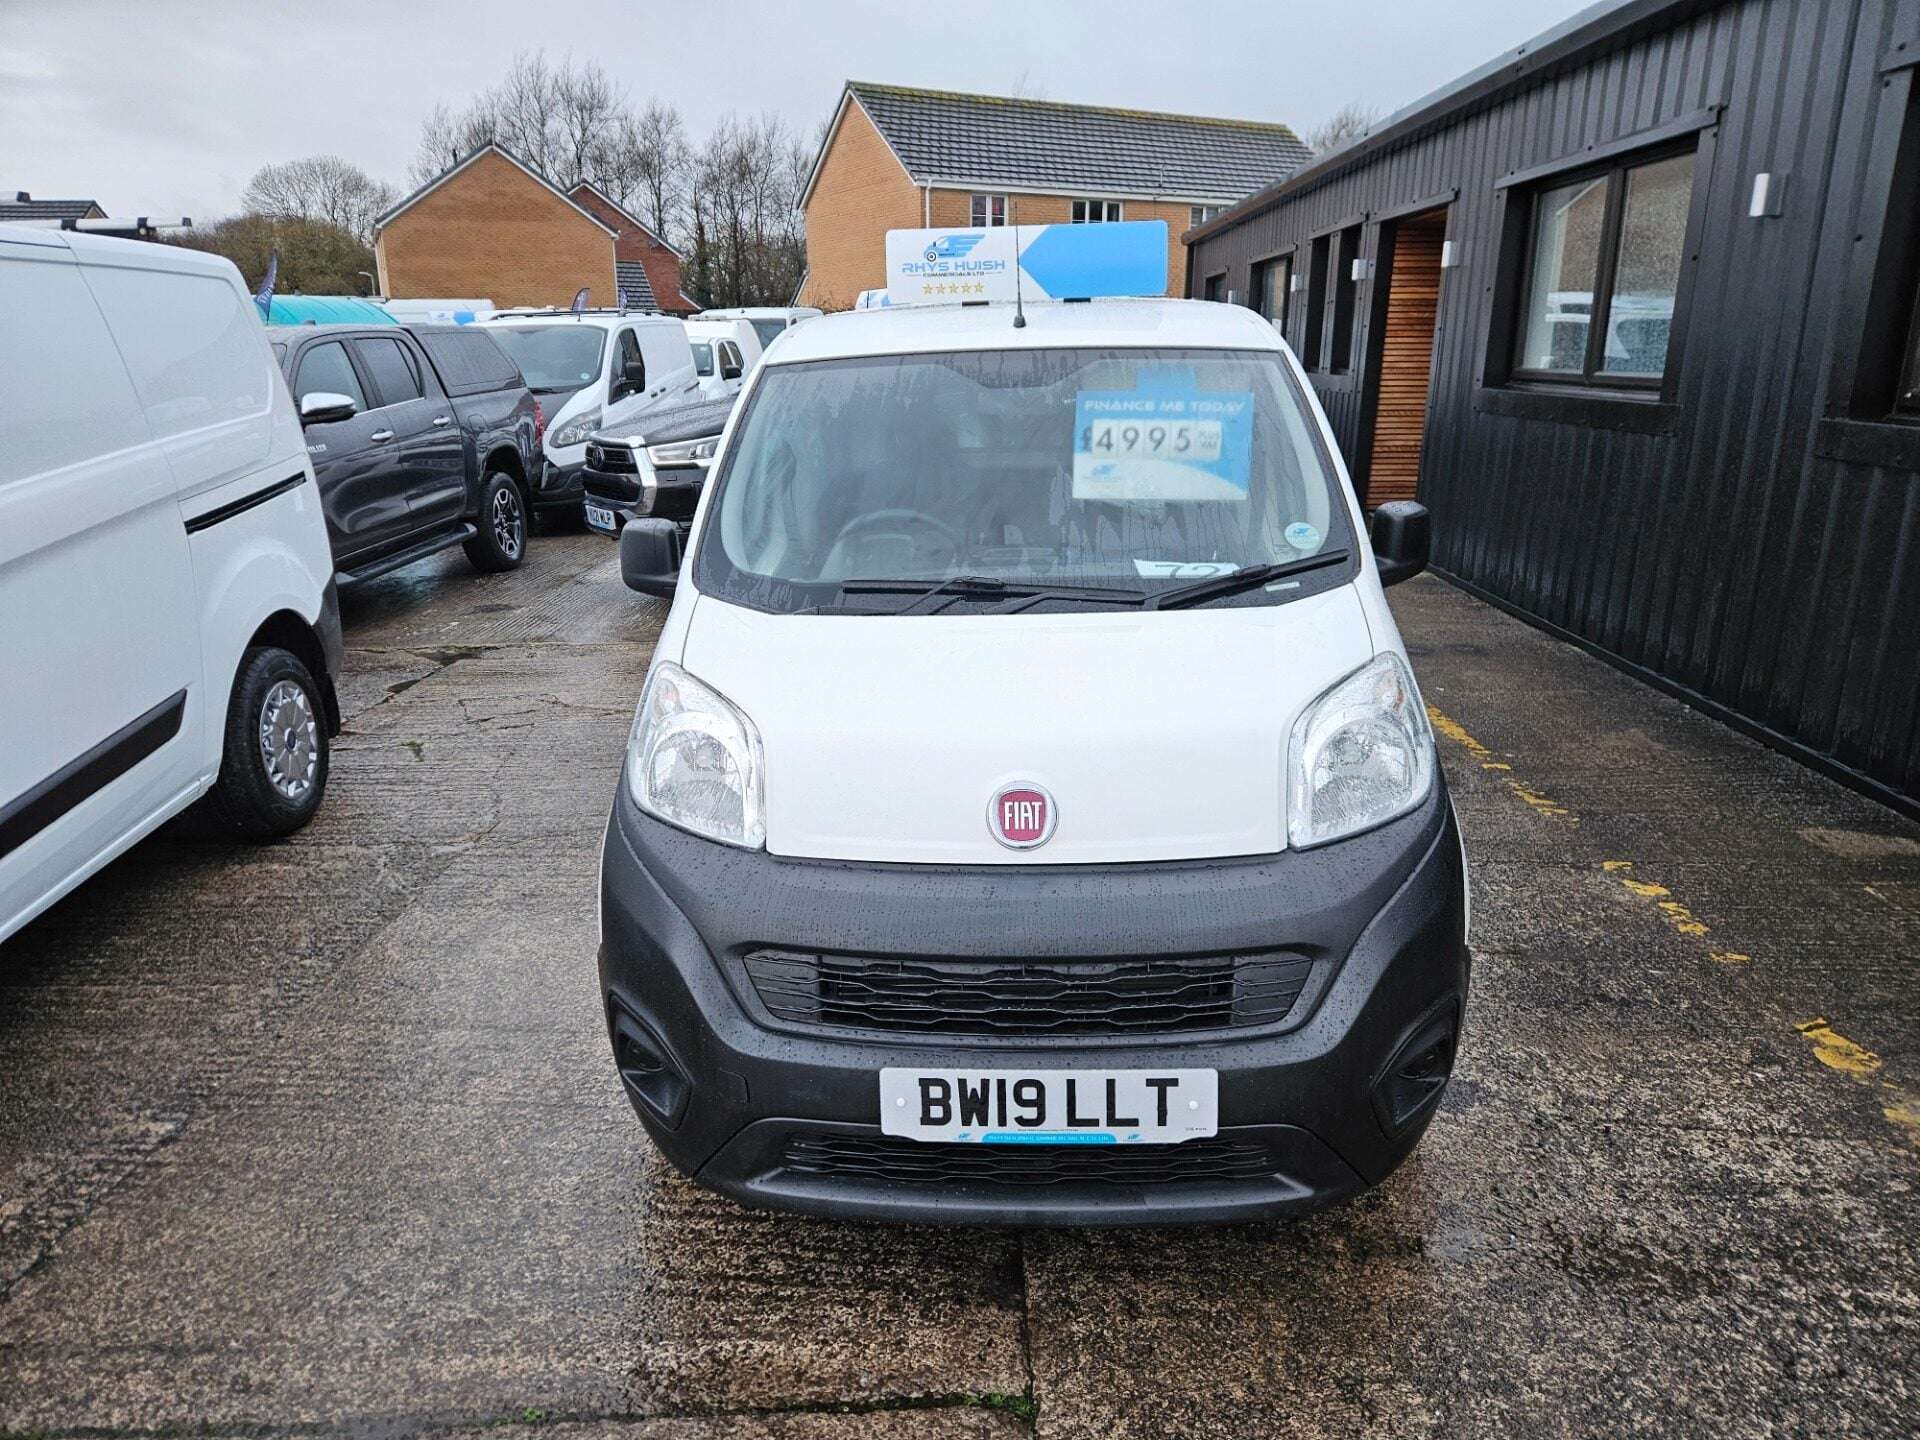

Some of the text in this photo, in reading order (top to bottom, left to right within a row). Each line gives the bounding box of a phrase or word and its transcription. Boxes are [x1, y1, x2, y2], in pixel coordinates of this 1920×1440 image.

[902, 259, 1006, 273] RHYS HUISH
[1084, 400, 1246, 414] FINANCE ME TODAY
[1004, 801, 1043, 830] FIAT
[918, 1077, 1179, 1128] BW19 LLT
